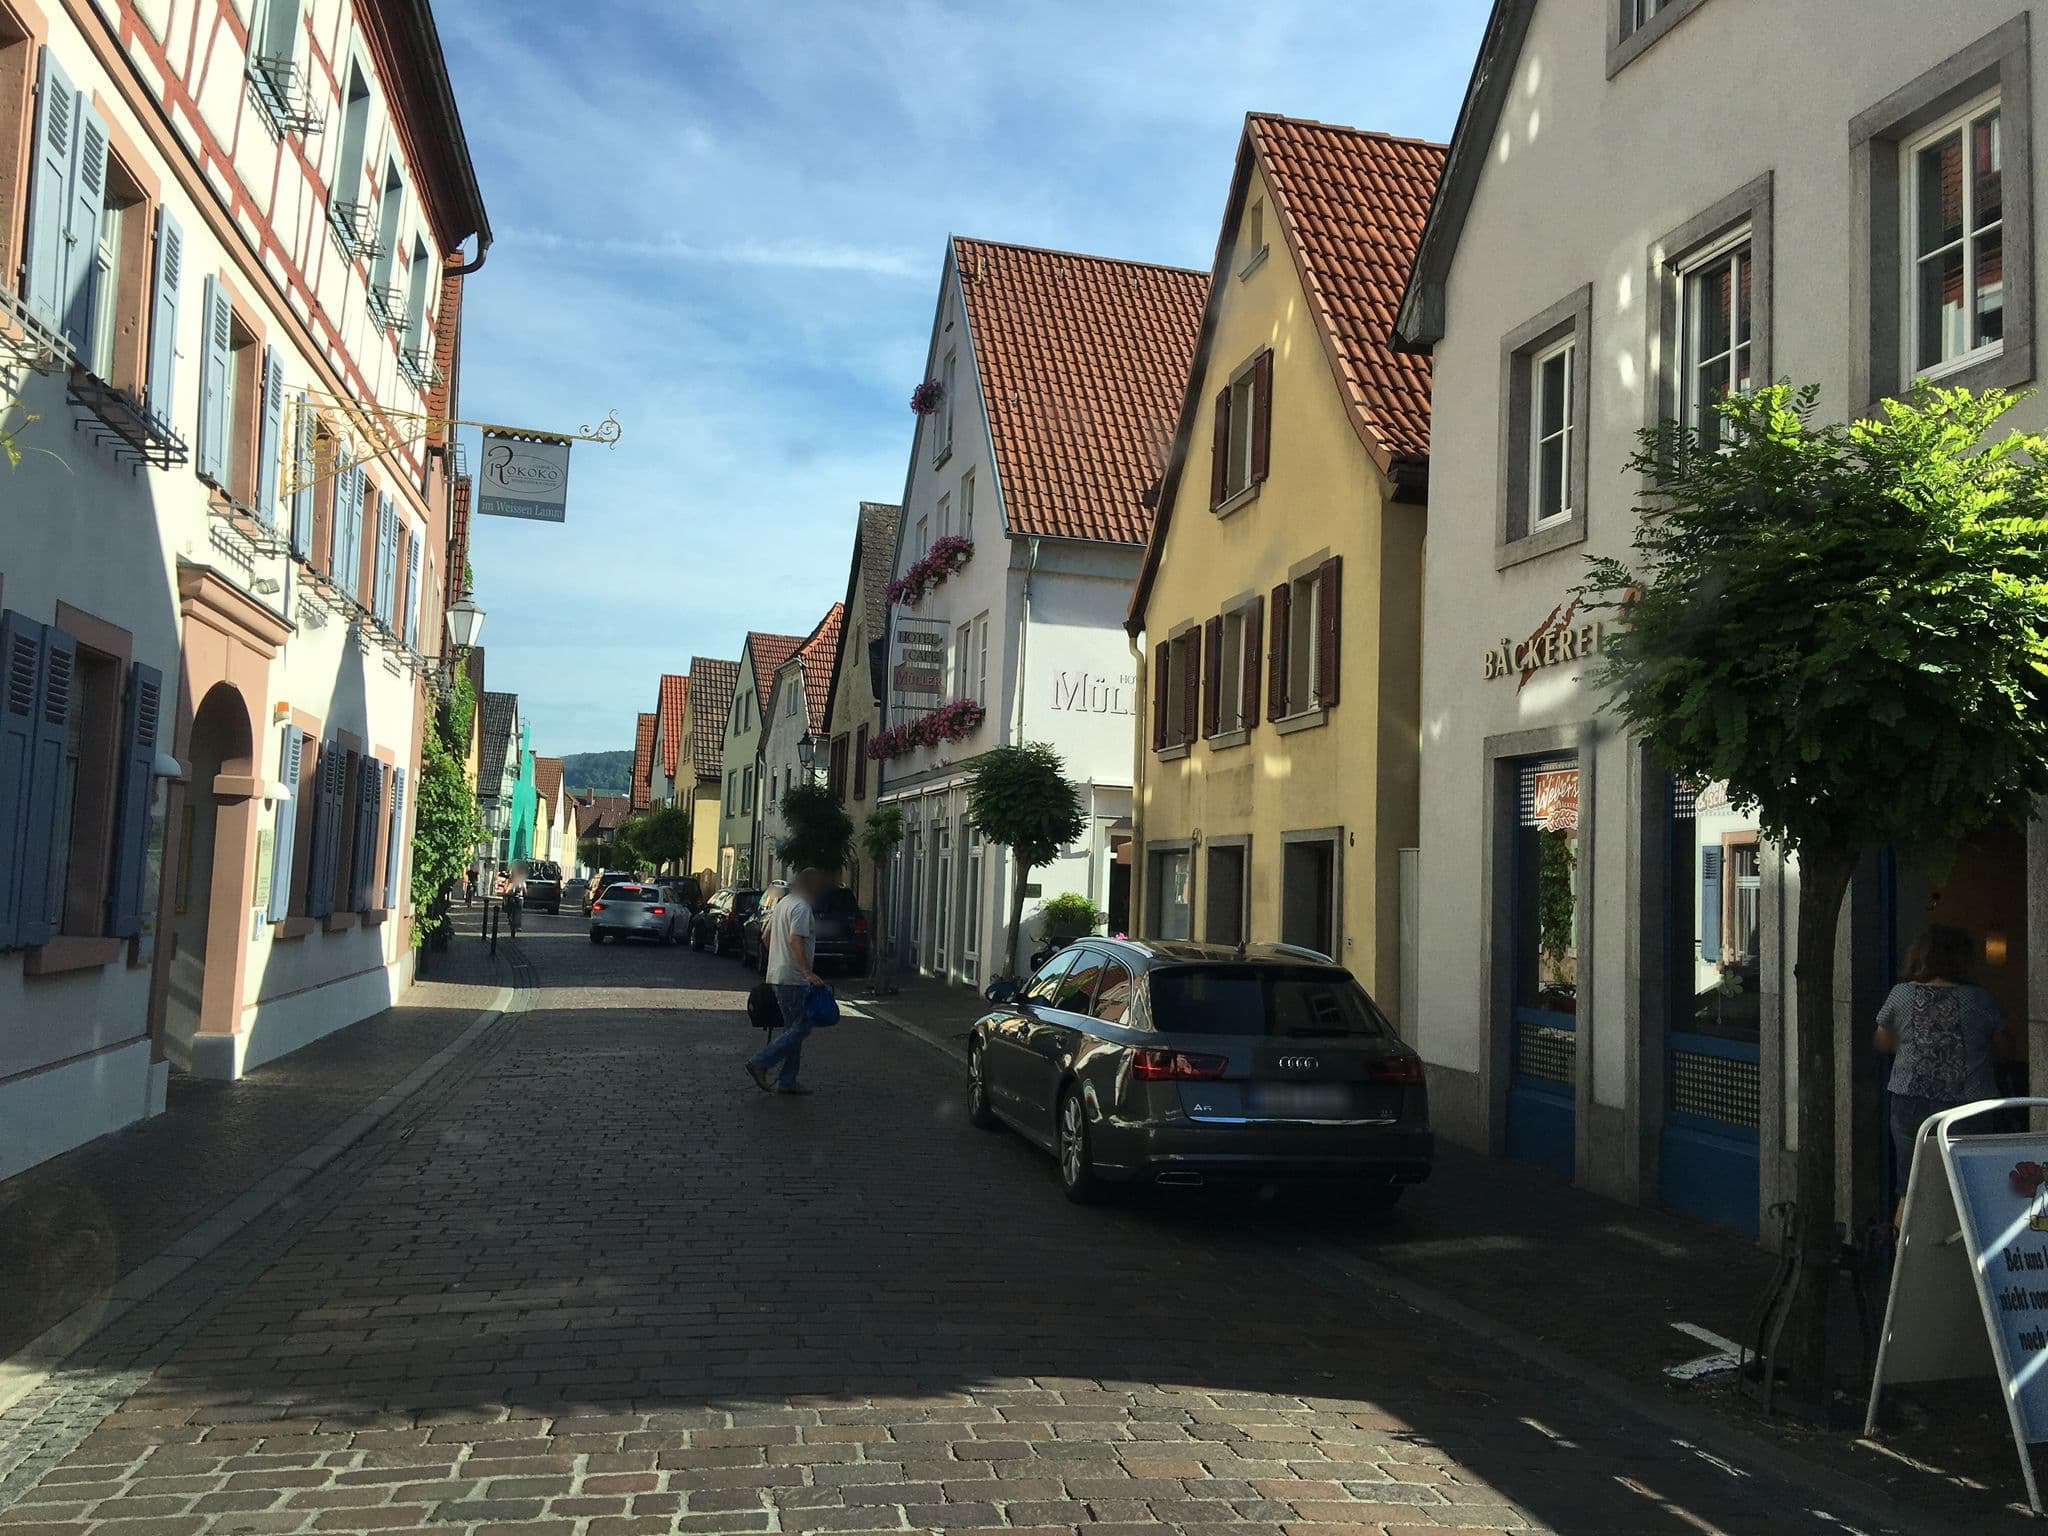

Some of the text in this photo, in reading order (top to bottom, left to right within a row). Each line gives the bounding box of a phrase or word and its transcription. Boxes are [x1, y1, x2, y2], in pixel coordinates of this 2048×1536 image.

[487, 445, 558, 485] ROKOKO
[481, 499, 563, 518] im Weissen Lamm
[899, 631, 940, 645] HOTEL
[1483, 621, 1604, 681] BÄCKEREI
[895, 671, 943, 689] MÜLLER
[1349, 831, 1356, 848] 6
[2003, 1246, 2023, 1272] Bei
[2024, 1251, 2044, 1271] uns
[2000, 1286, 2029, 1312] nicht
[2018, 1324, 2047, 1351] noch
